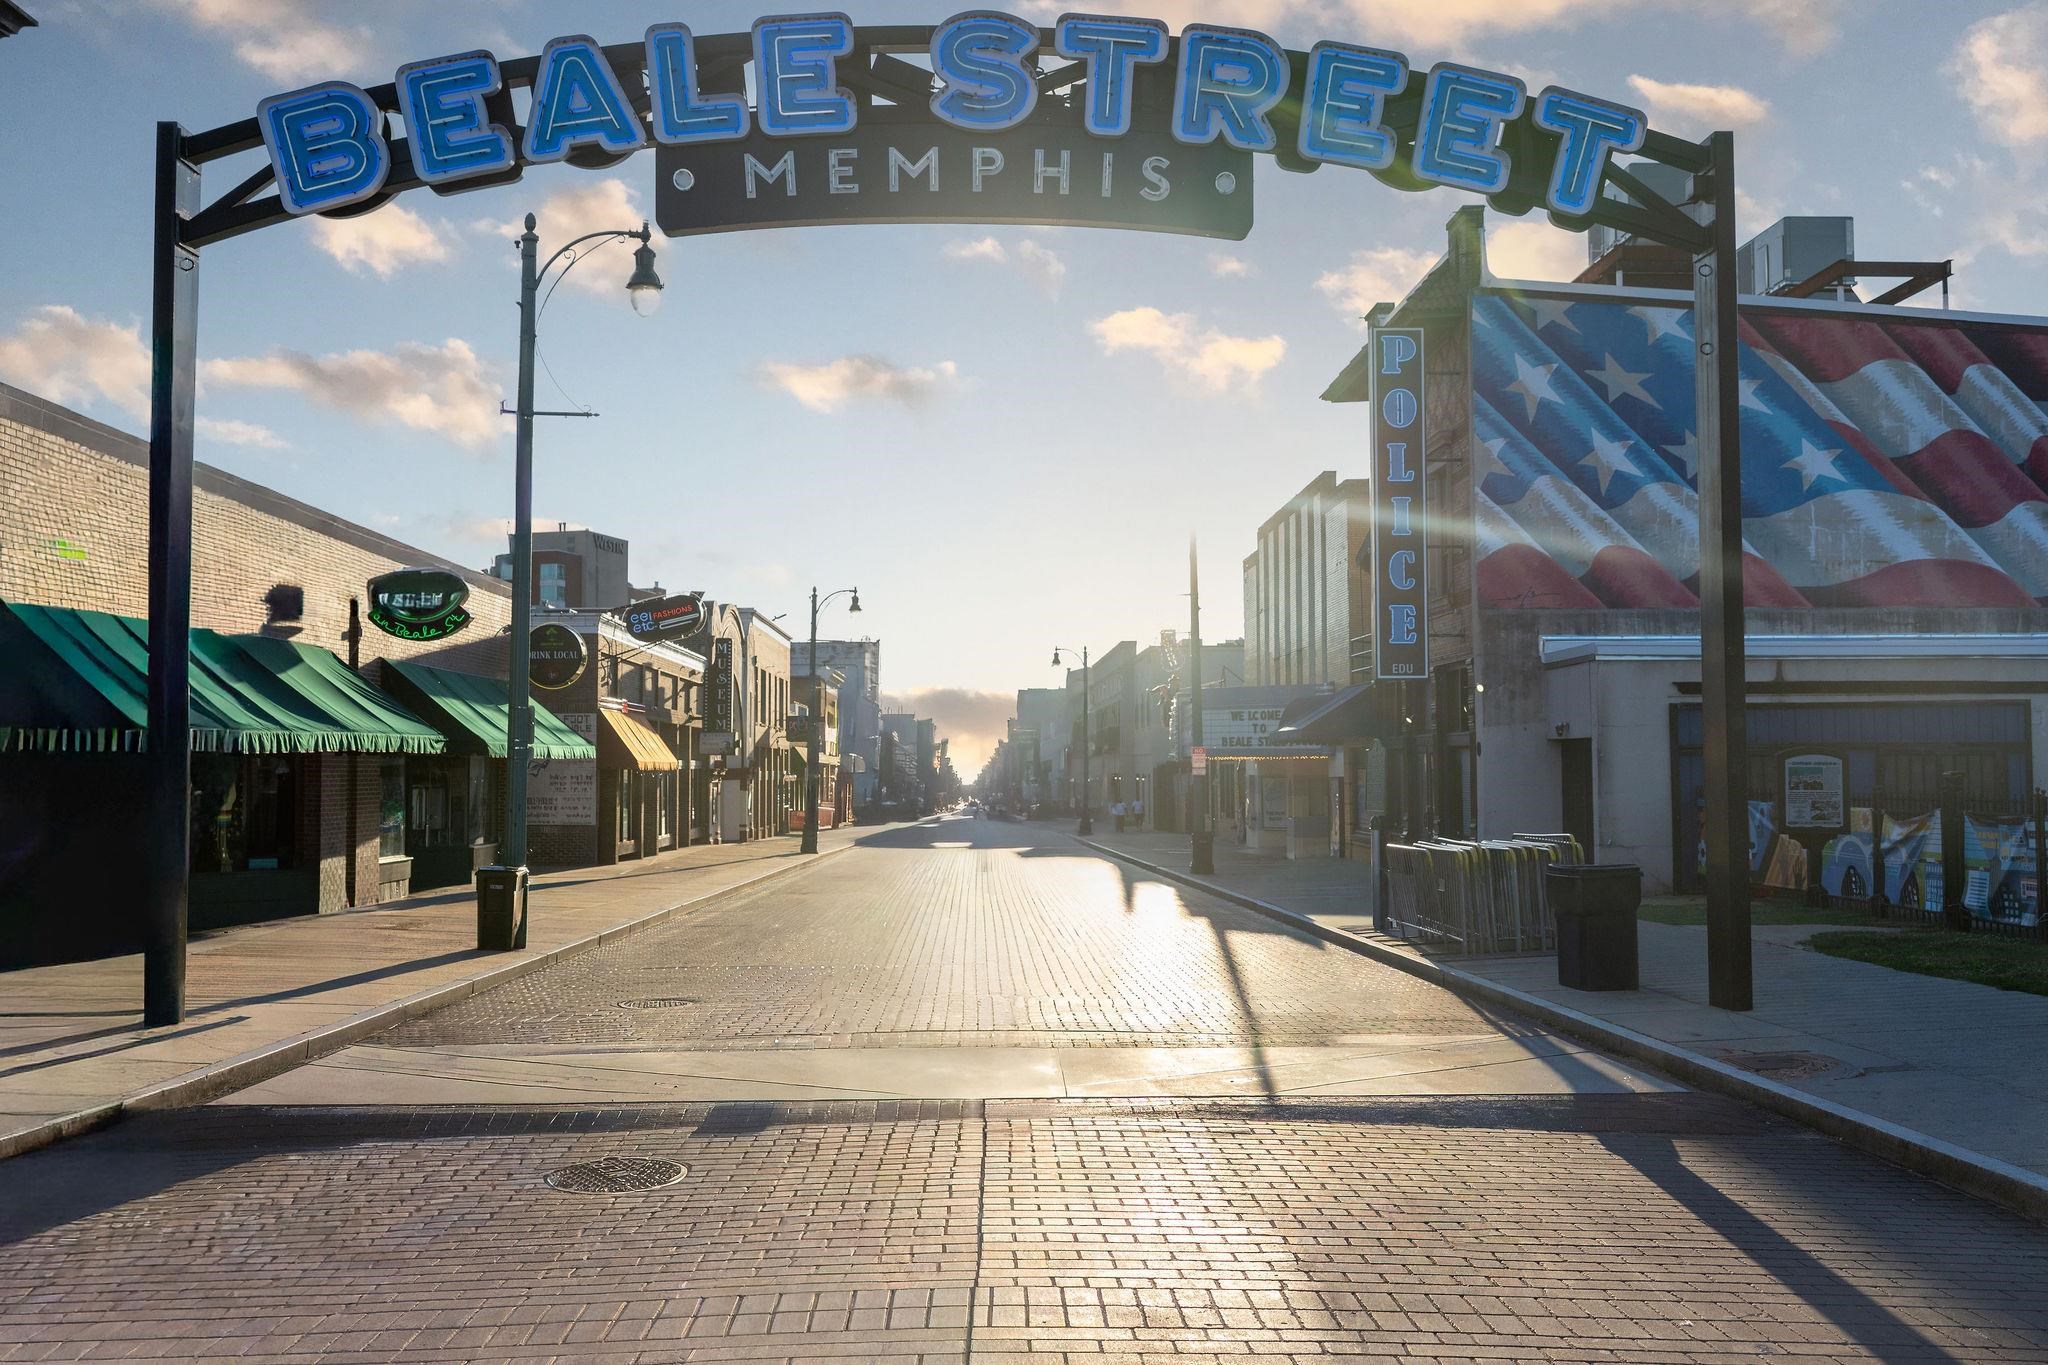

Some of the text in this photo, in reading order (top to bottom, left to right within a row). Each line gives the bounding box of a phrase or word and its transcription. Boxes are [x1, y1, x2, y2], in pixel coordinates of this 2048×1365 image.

[258, 10, 1648, 217] BEALE STREET
[744, 146, 1171, 203] MEMPHIS
[1380, 334, 1418, 645] POLICE
[652, 604, 694, 620] FASHIONS
[395, 621, 443, 639] Beale
[529, 650, 578, 660] RINK LOCAL
[1391, 663, 1414, 675] EDU
[716, 642, 728, 730] MUSEUM
[1251, 723, 1267, 735] TO
[1221, 736, 1253, 747] BEALE
